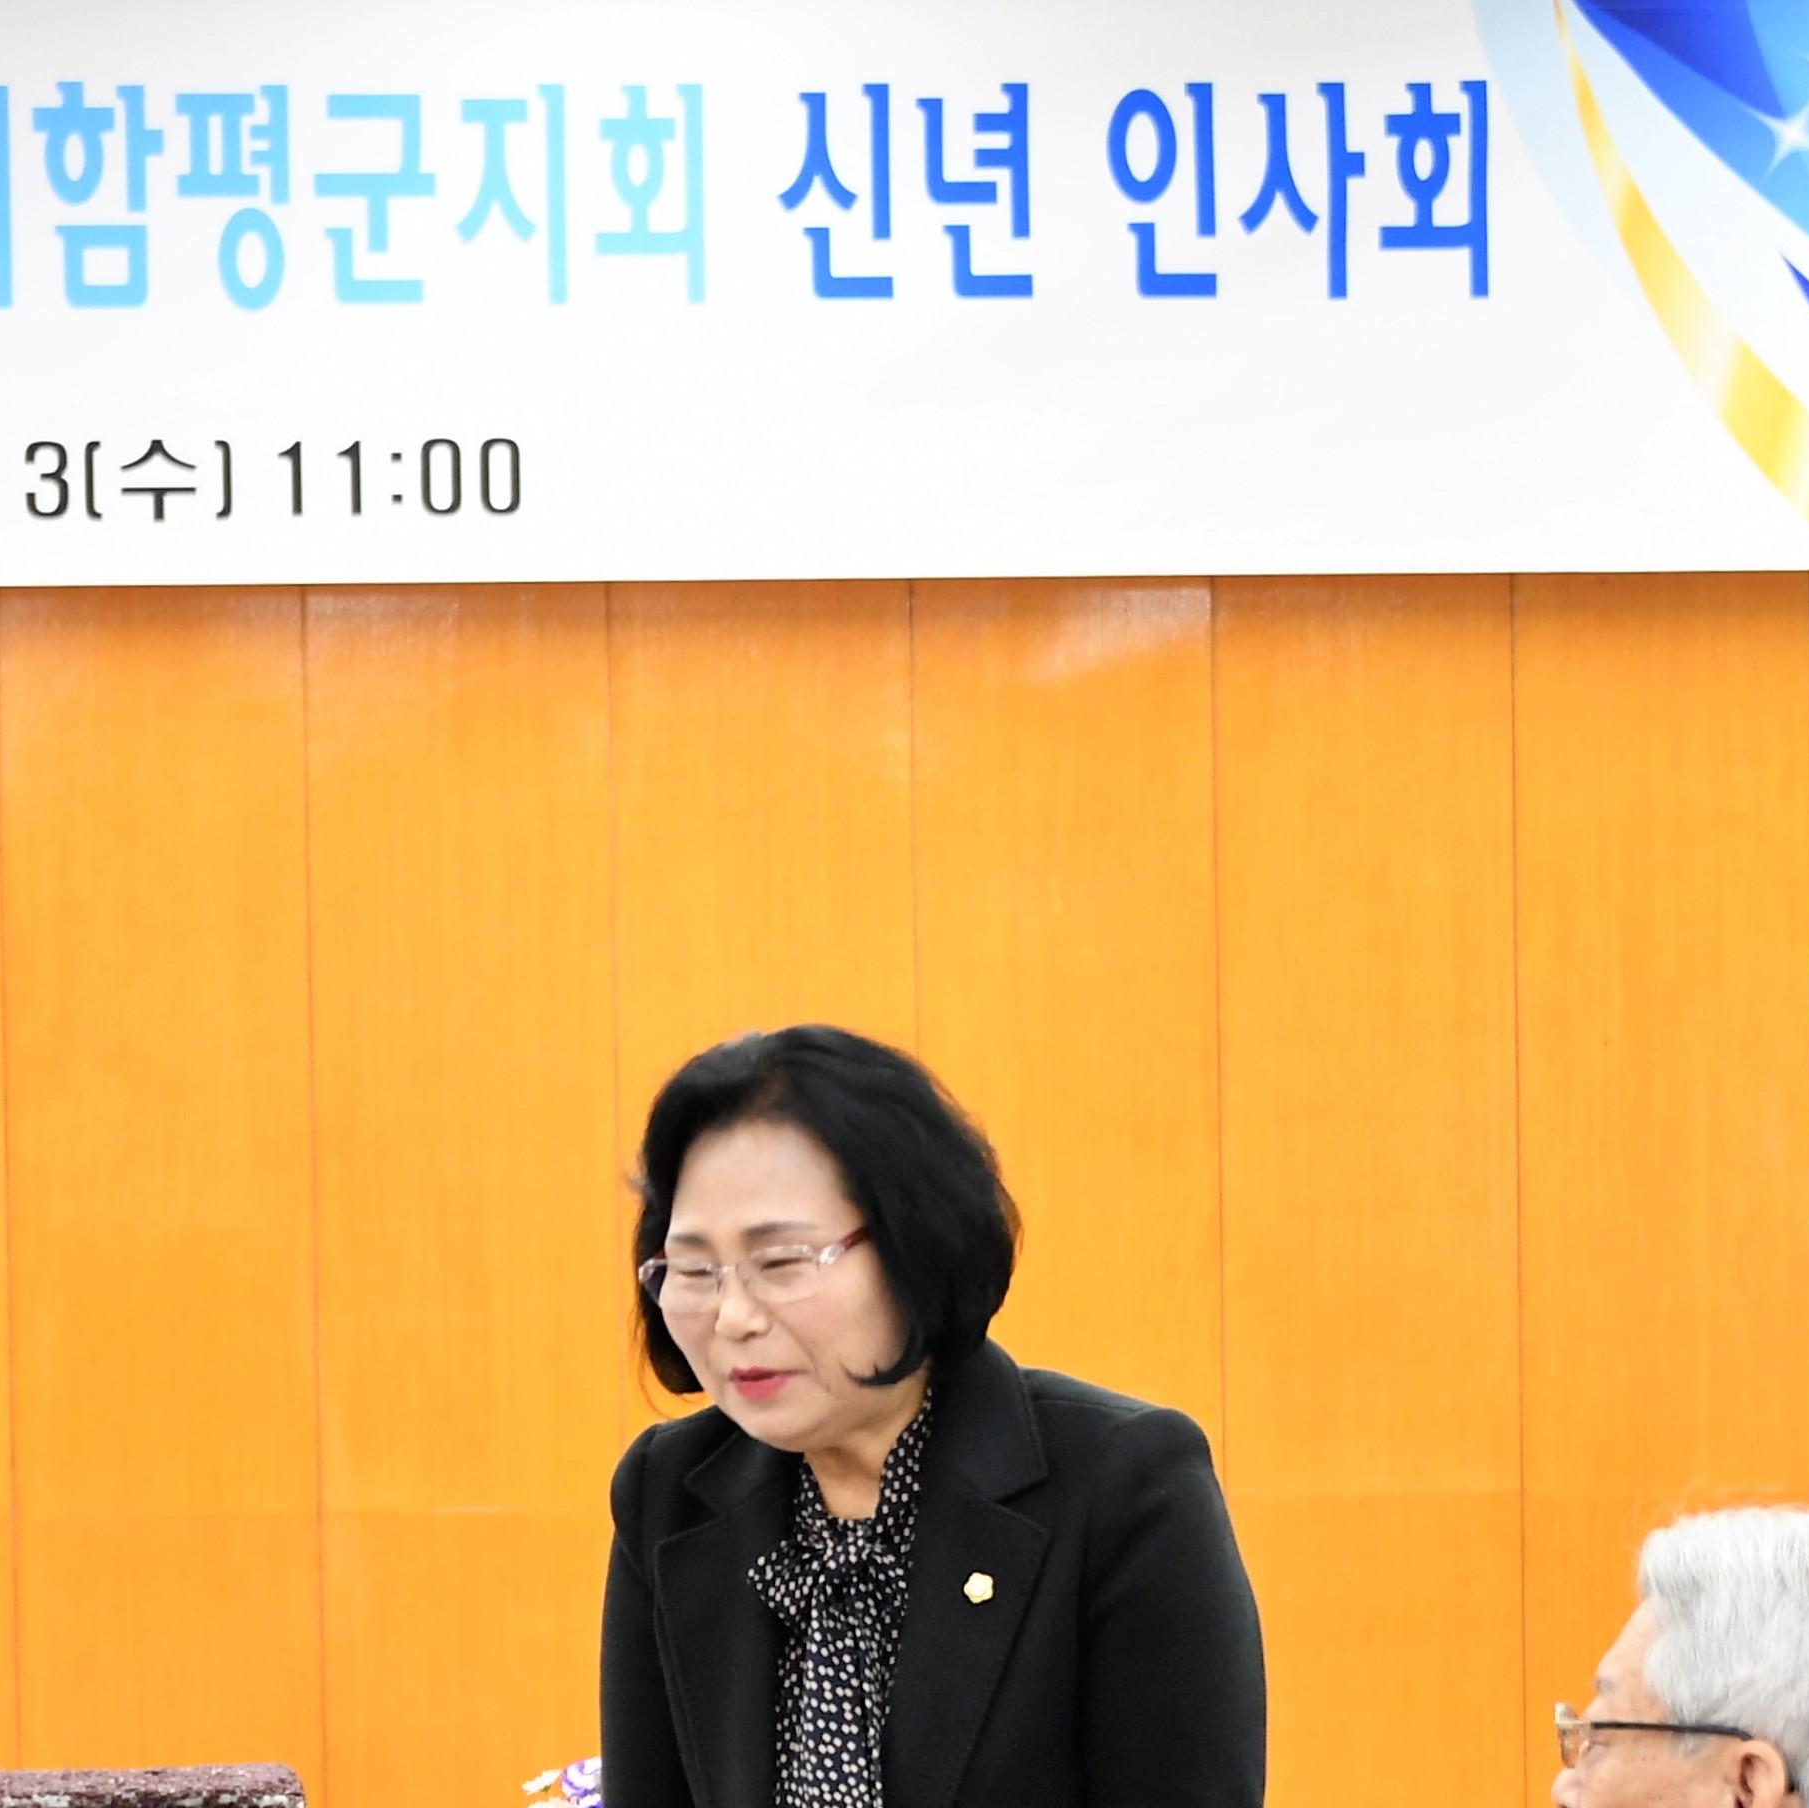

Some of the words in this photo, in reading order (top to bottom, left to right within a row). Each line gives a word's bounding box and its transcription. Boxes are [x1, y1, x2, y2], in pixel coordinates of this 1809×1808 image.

[777, 82, 1034, 300] 신년
[1105, 79, 1490, 300] 인사회
[277, 437, 521, 516] 11:00
